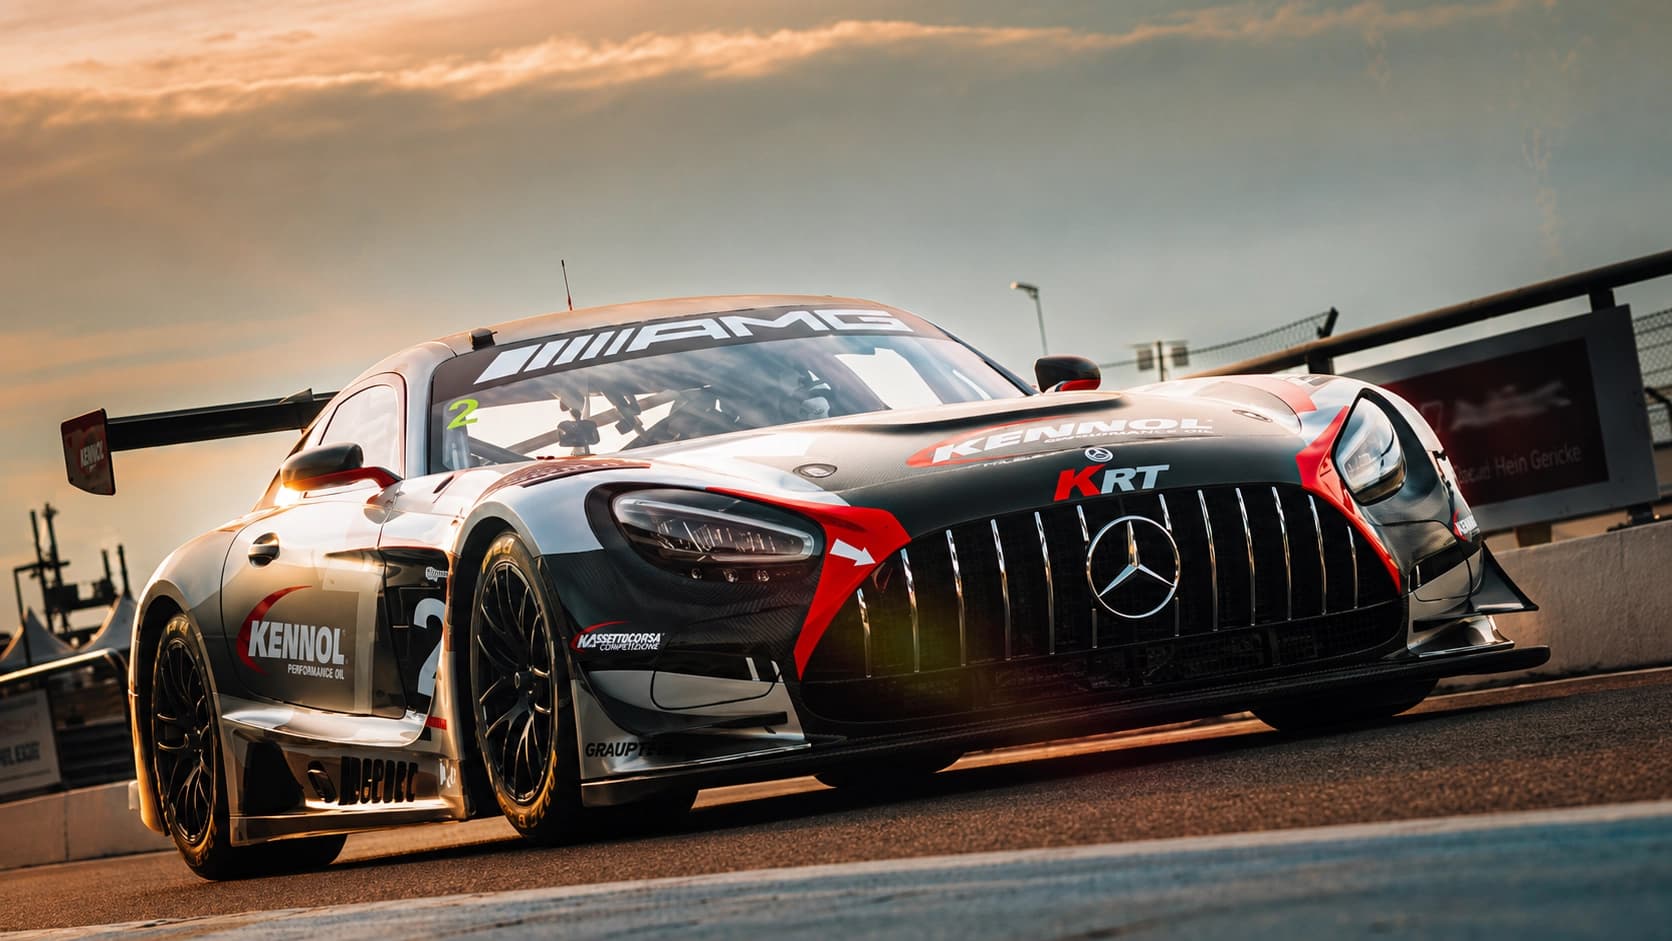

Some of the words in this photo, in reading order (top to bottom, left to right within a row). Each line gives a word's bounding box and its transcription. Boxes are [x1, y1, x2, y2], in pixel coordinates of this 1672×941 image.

[625, 308, 914, 353] AMG
[447, 399, 479, 430] 2
[931, 418, 1213, 464] KENNOL
[1495, 455, 1529, 476] Hein
[1530, 443, 1583, 471] Gericke
[1053, 463, 1170, 502] KRT
[248, 620, 345, 665] KENNOL
[288, 664, 333, 680] PERFORMANCE
[334, 668, 345, 680] OIL
